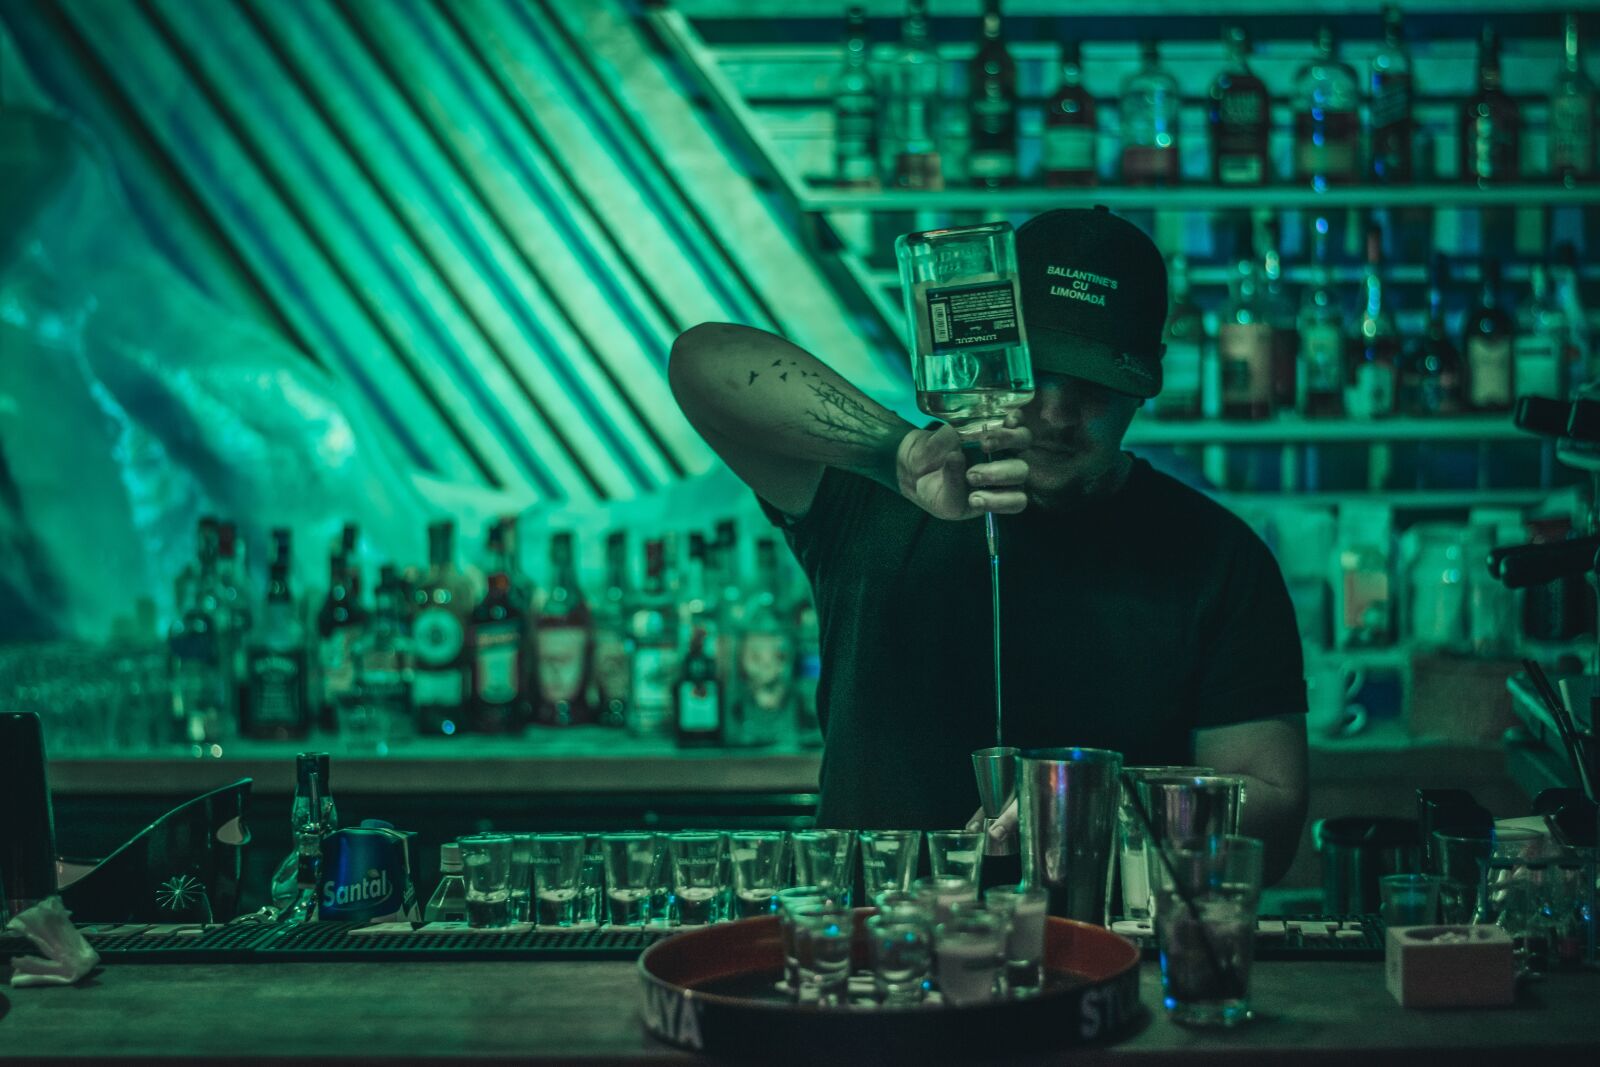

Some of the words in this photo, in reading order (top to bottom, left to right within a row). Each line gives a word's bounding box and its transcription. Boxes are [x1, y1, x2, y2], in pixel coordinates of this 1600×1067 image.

[1047, 265, 1118, 290] BALLANTINE'S
[1072, 280, 1089, 291] CU
[955, 334, 998, 345] LUNAZUL
